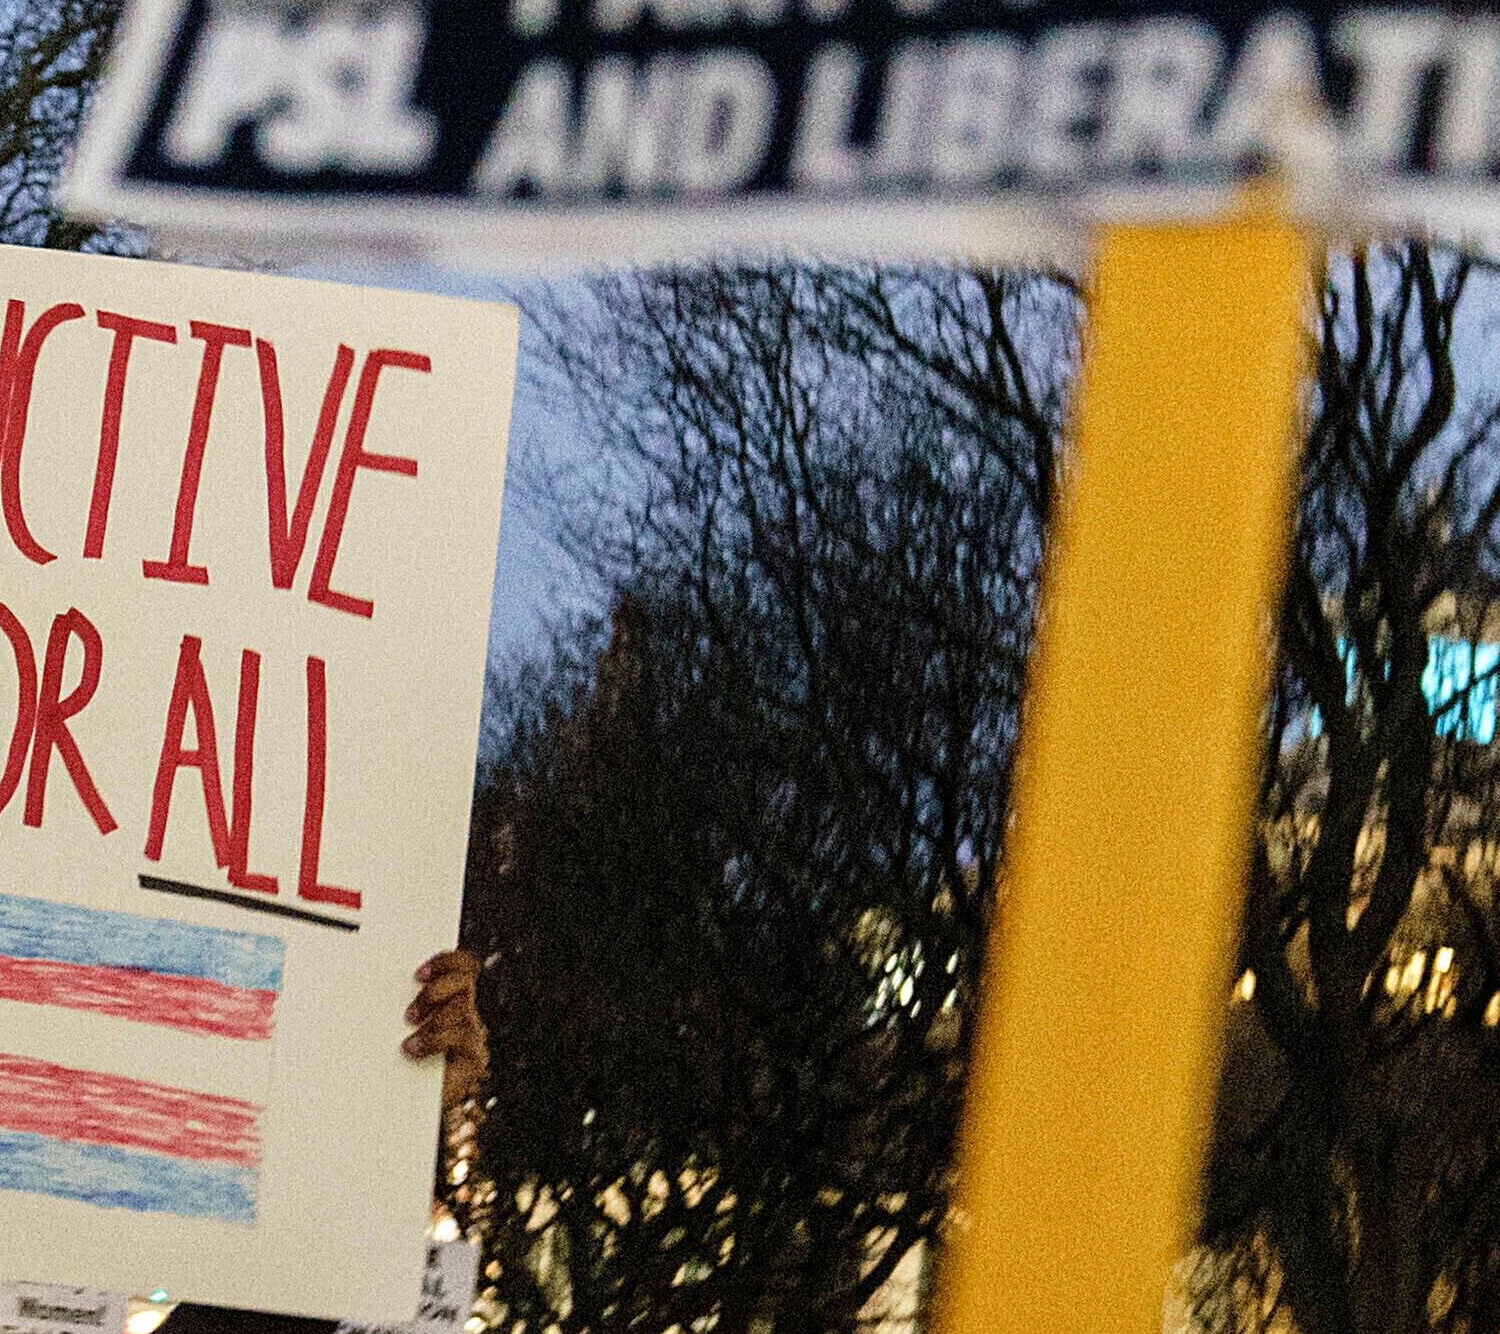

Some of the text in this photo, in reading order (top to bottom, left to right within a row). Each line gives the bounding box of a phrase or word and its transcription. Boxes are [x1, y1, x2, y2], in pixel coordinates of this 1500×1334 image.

[163, 7, 440, 175] PSL
[470, 45, 778, 202] AND
[143, 636, 364, 909] ALL
